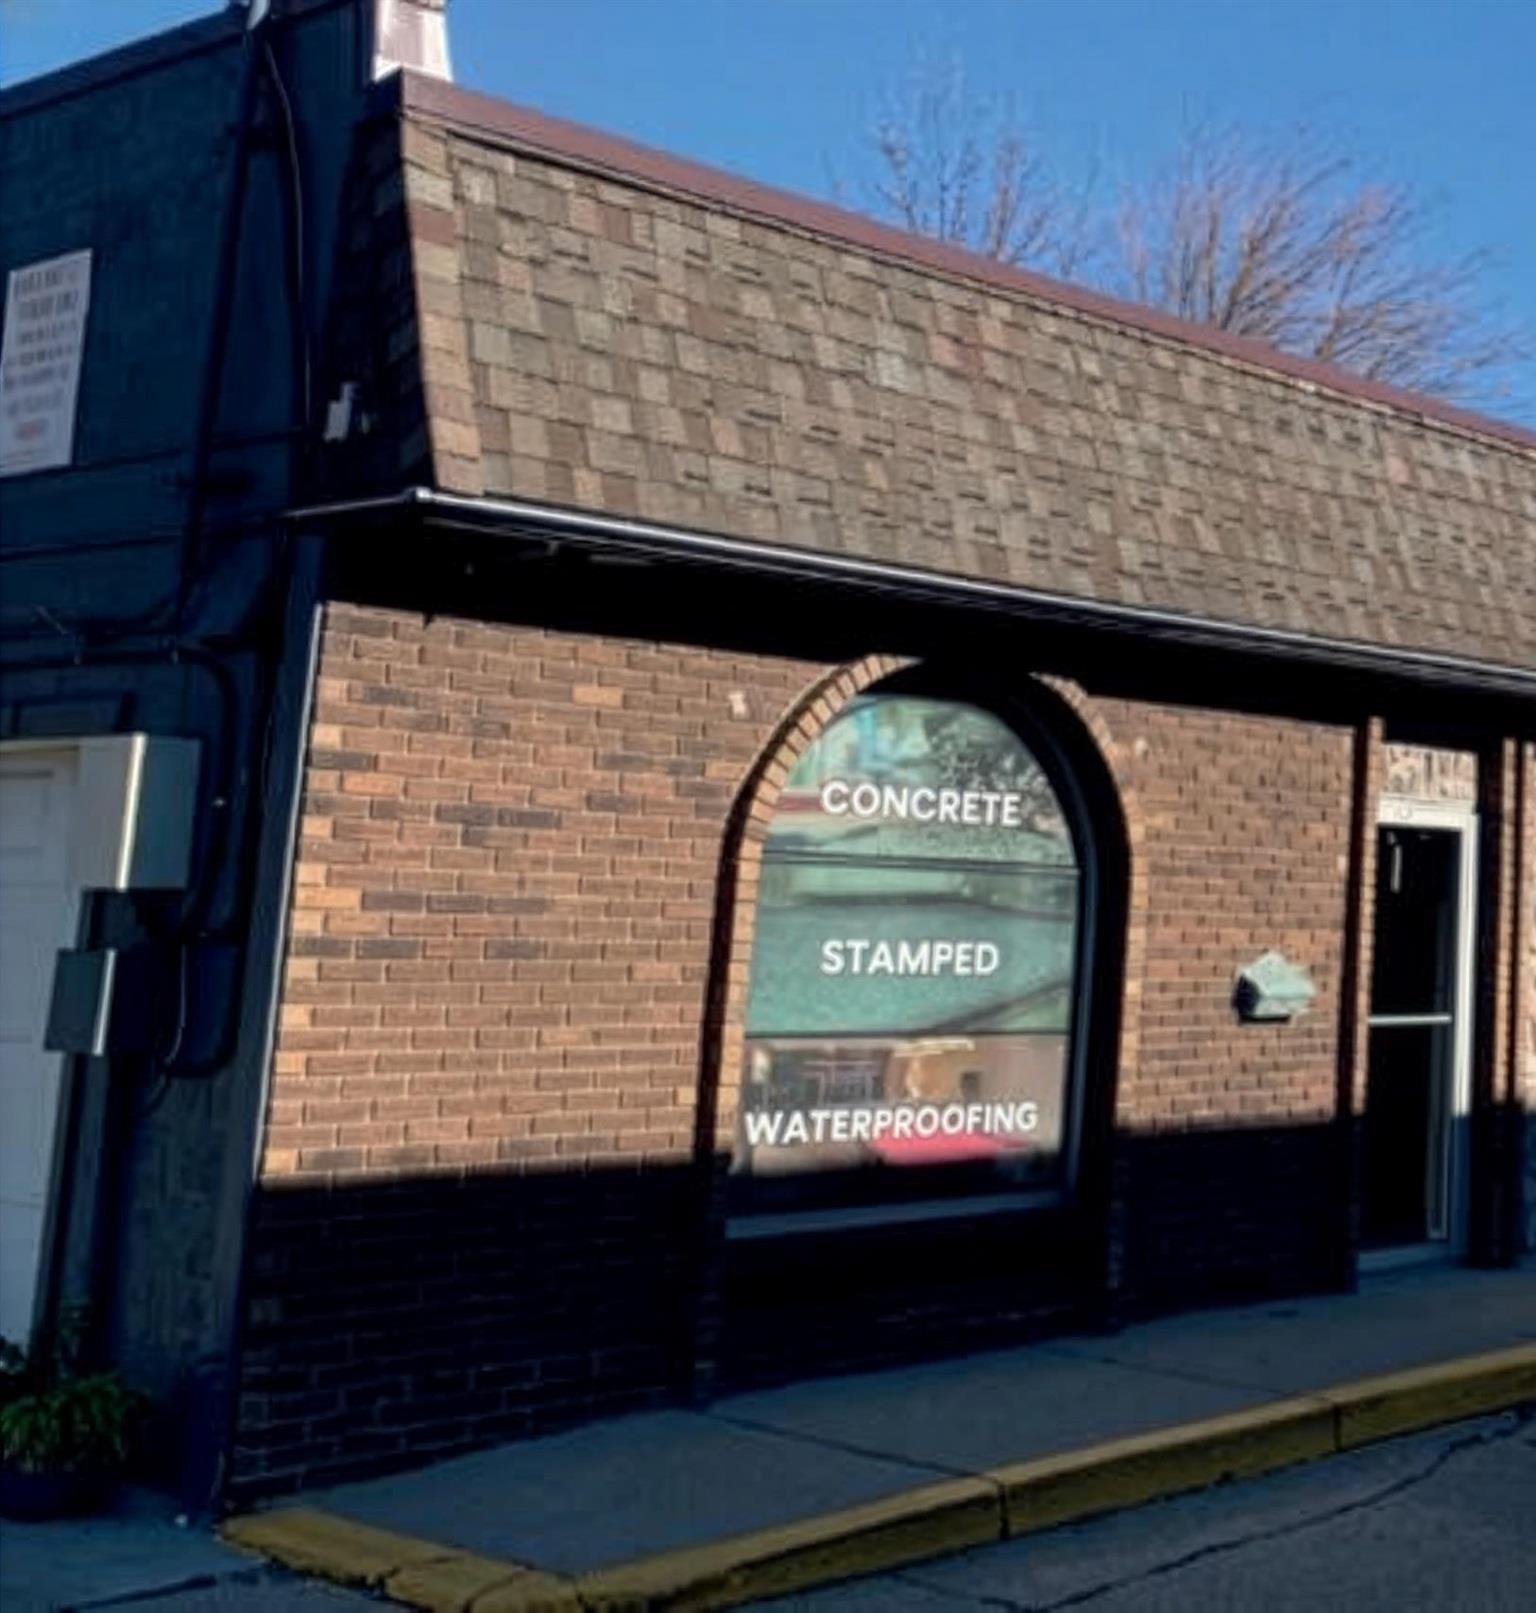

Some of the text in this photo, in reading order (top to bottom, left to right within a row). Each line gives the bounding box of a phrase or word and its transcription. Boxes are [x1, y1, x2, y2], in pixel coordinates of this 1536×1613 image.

[821, 780, 1022, 827] CONCRETE
[820, 939, 1000, 976] STAMPED
[744, 1101, 1039, 1145] WATERPROOFING
